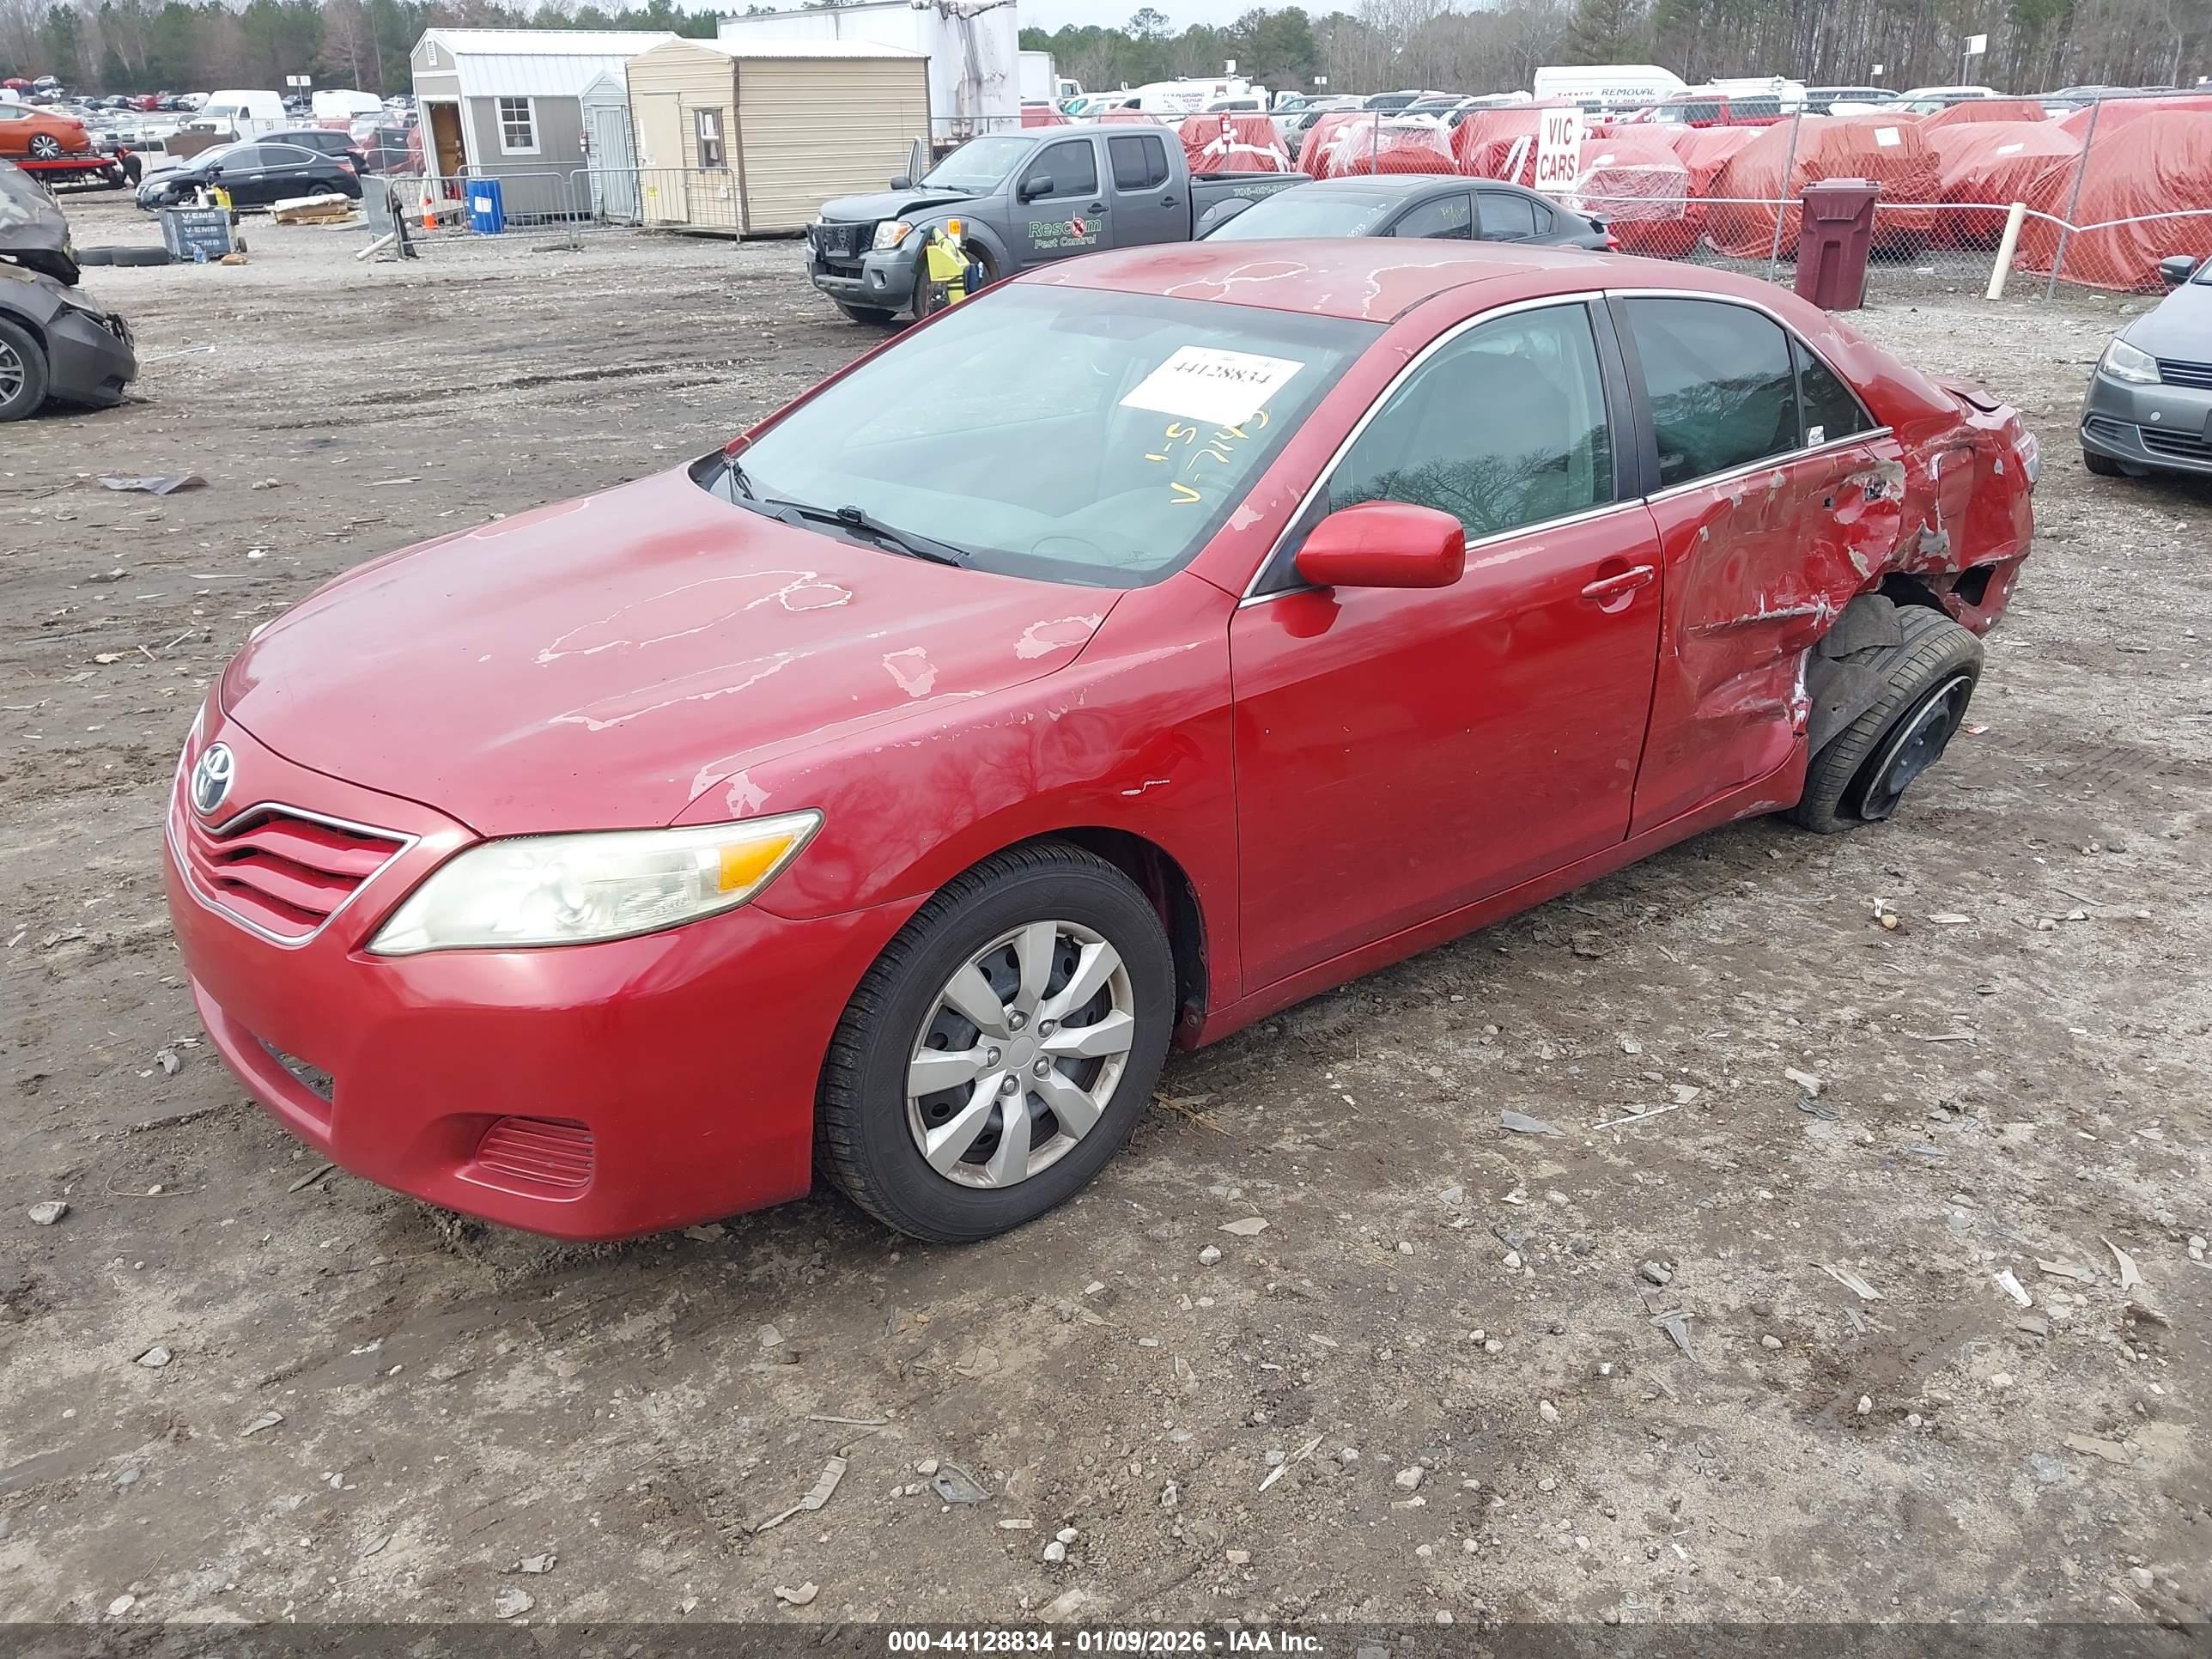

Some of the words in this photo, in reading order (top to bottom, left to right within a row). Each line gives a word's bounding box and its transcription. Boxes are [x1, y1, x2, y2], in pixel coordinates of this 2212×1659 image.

[1601, 88, 1656, 96] REMOVAL
[1549, 117, 1573, 145] VIC
[1540, 153, 1576, 181] CARS
[1034, 238, 1059, 250] Pest
[1060, 234, 1097, 247] Control
[1173, 362, 1273, 384] 44128834
